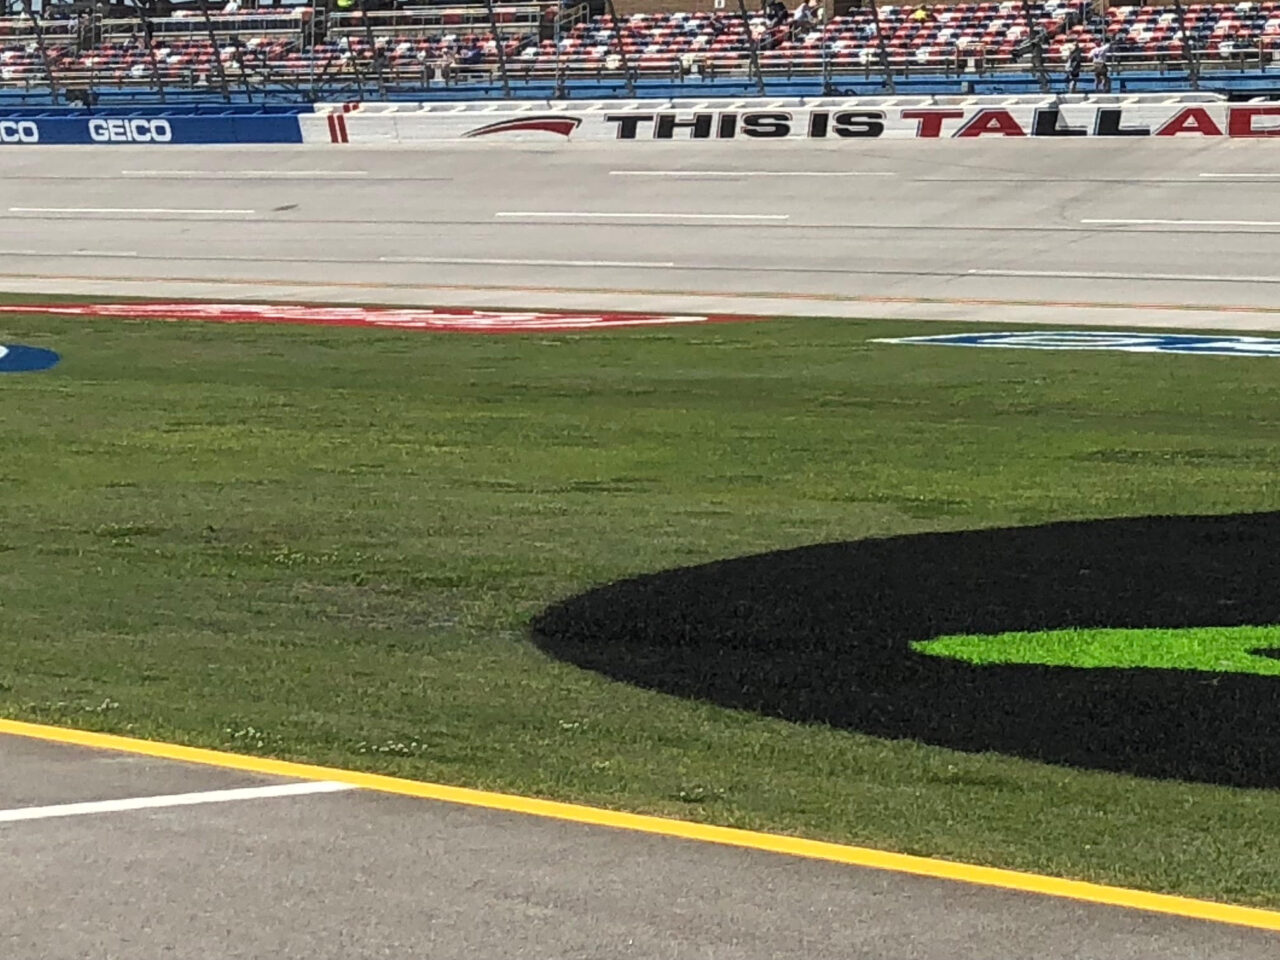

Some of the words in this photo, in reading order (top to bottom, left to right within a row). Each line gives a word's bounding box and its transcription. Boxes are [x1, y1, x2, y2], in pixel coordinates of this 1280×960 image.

[88, 119, 172, 141] GEICO
[604, 111, 793, 139] THIS
[807, 110, 887, 139] IS
